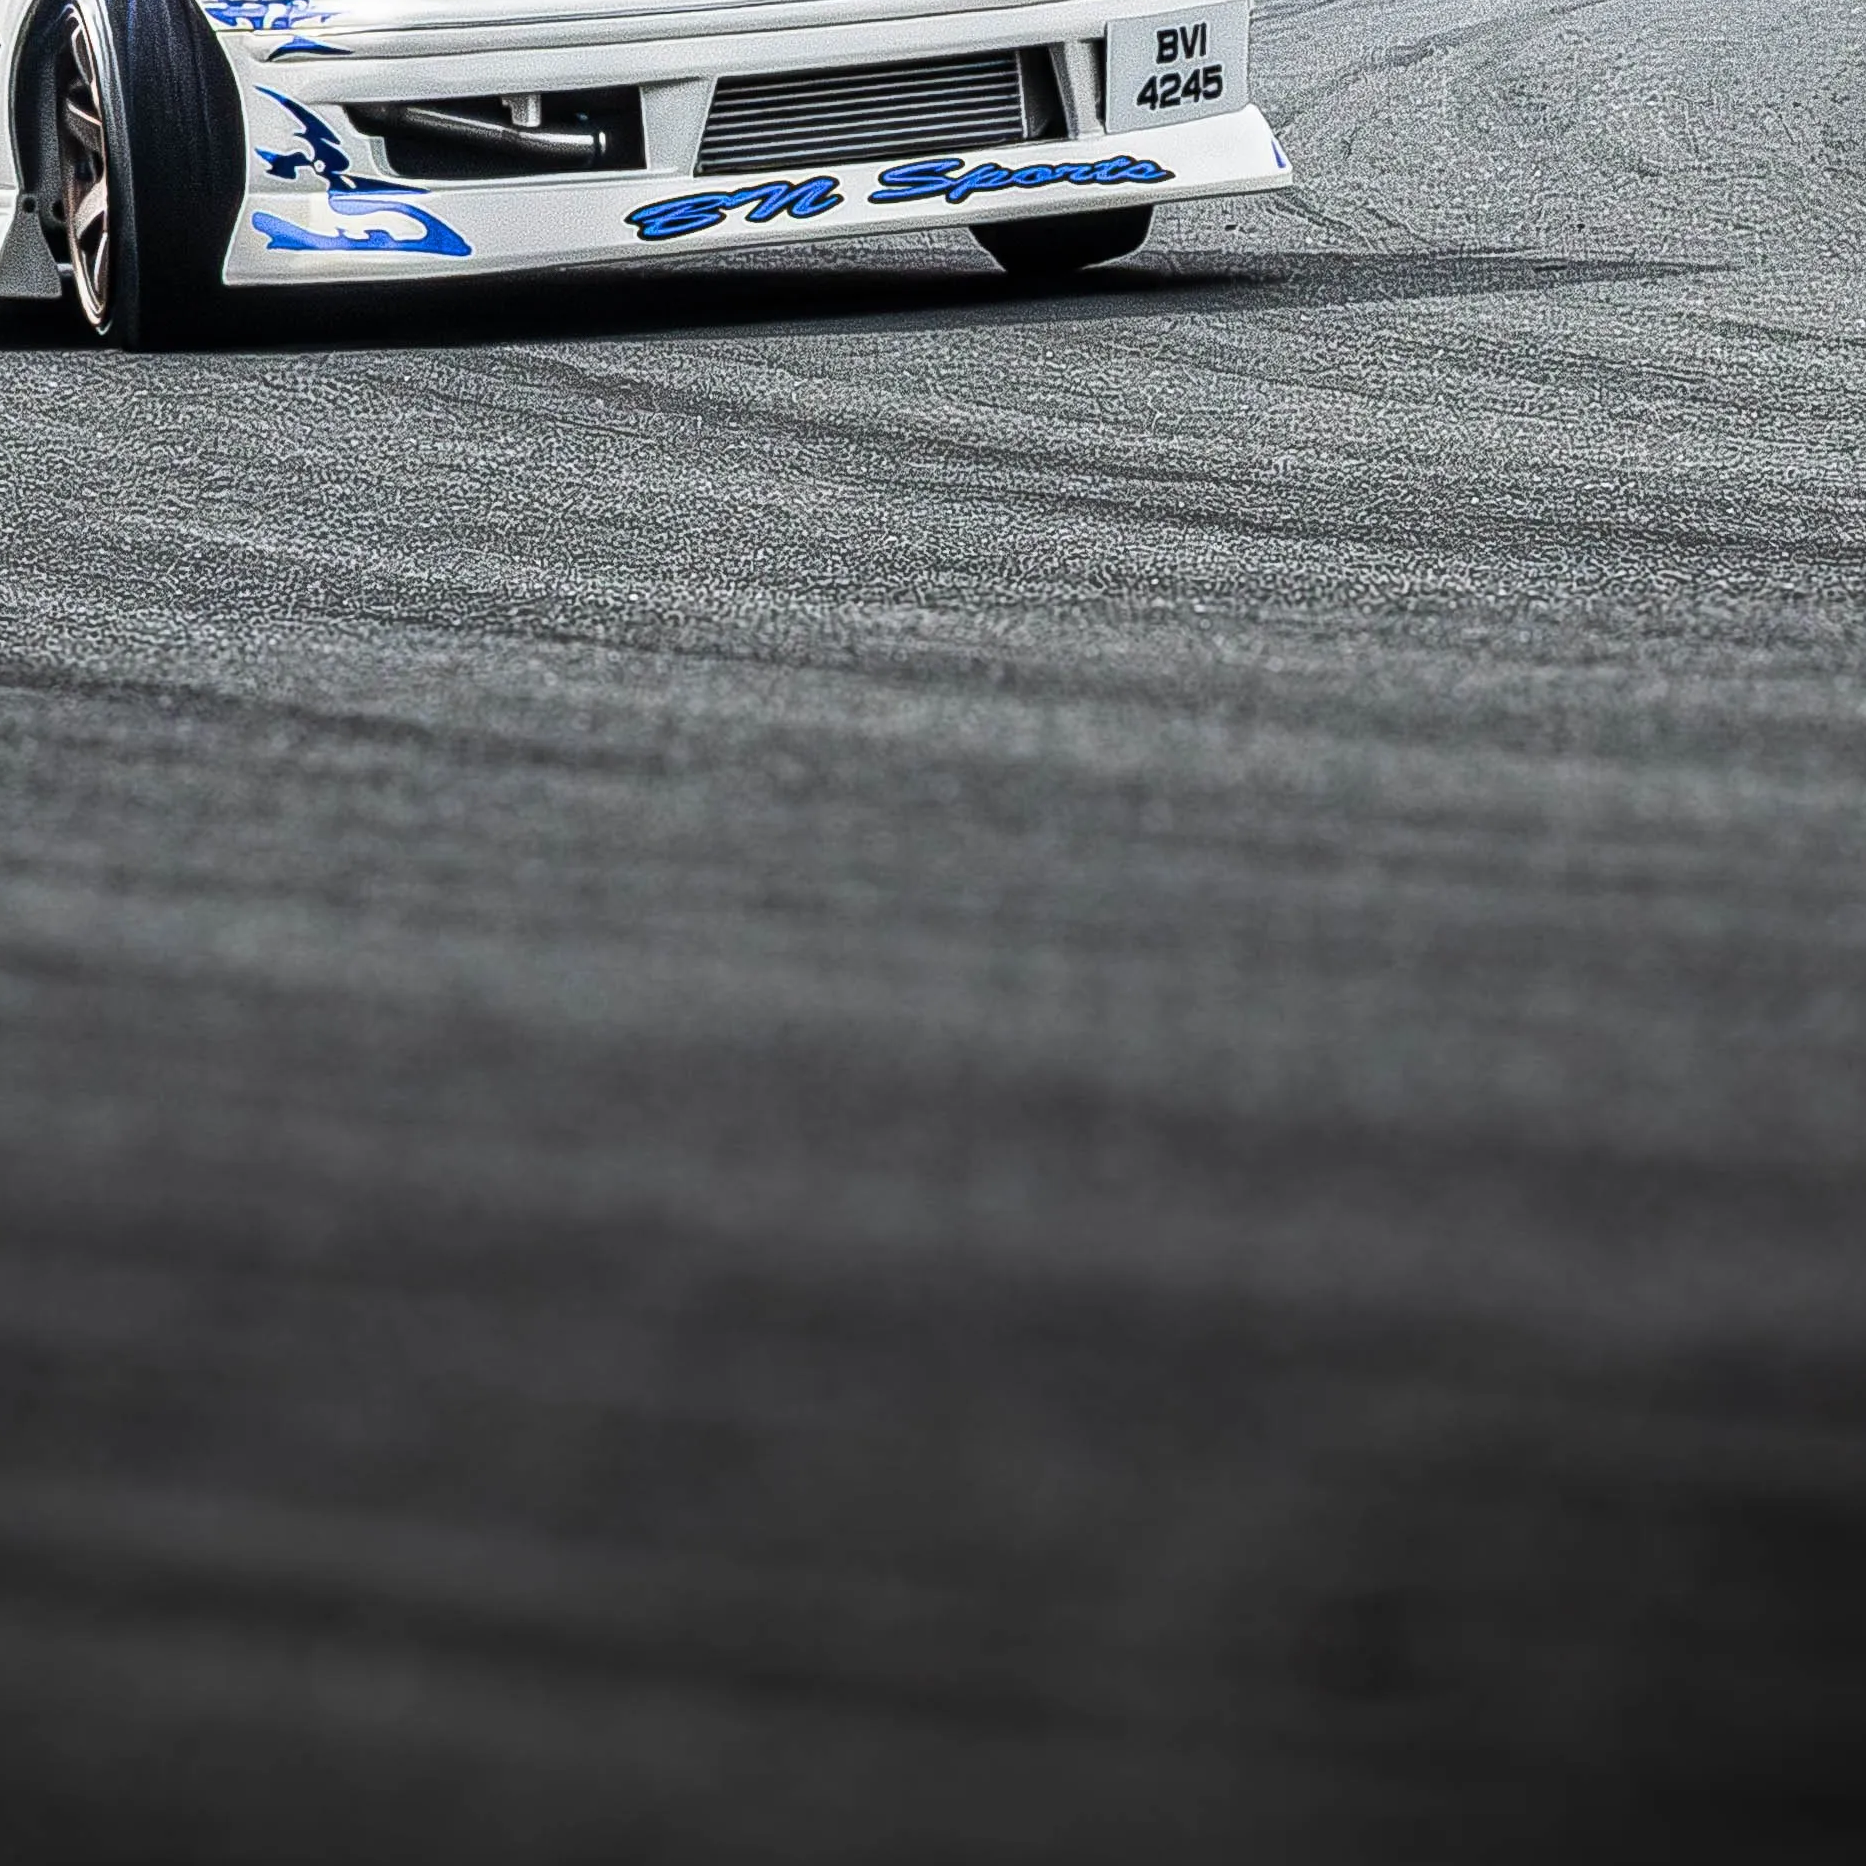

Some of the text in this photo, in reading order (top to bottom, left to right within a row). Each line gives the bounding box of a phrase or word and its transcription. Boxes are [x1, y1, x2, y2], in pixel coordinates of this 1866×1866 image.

[1156, 22, 1207, 64] BVI
[1136, 64, 1223, 111] 4245
[623, 154, 1176, 241] BN Sports
